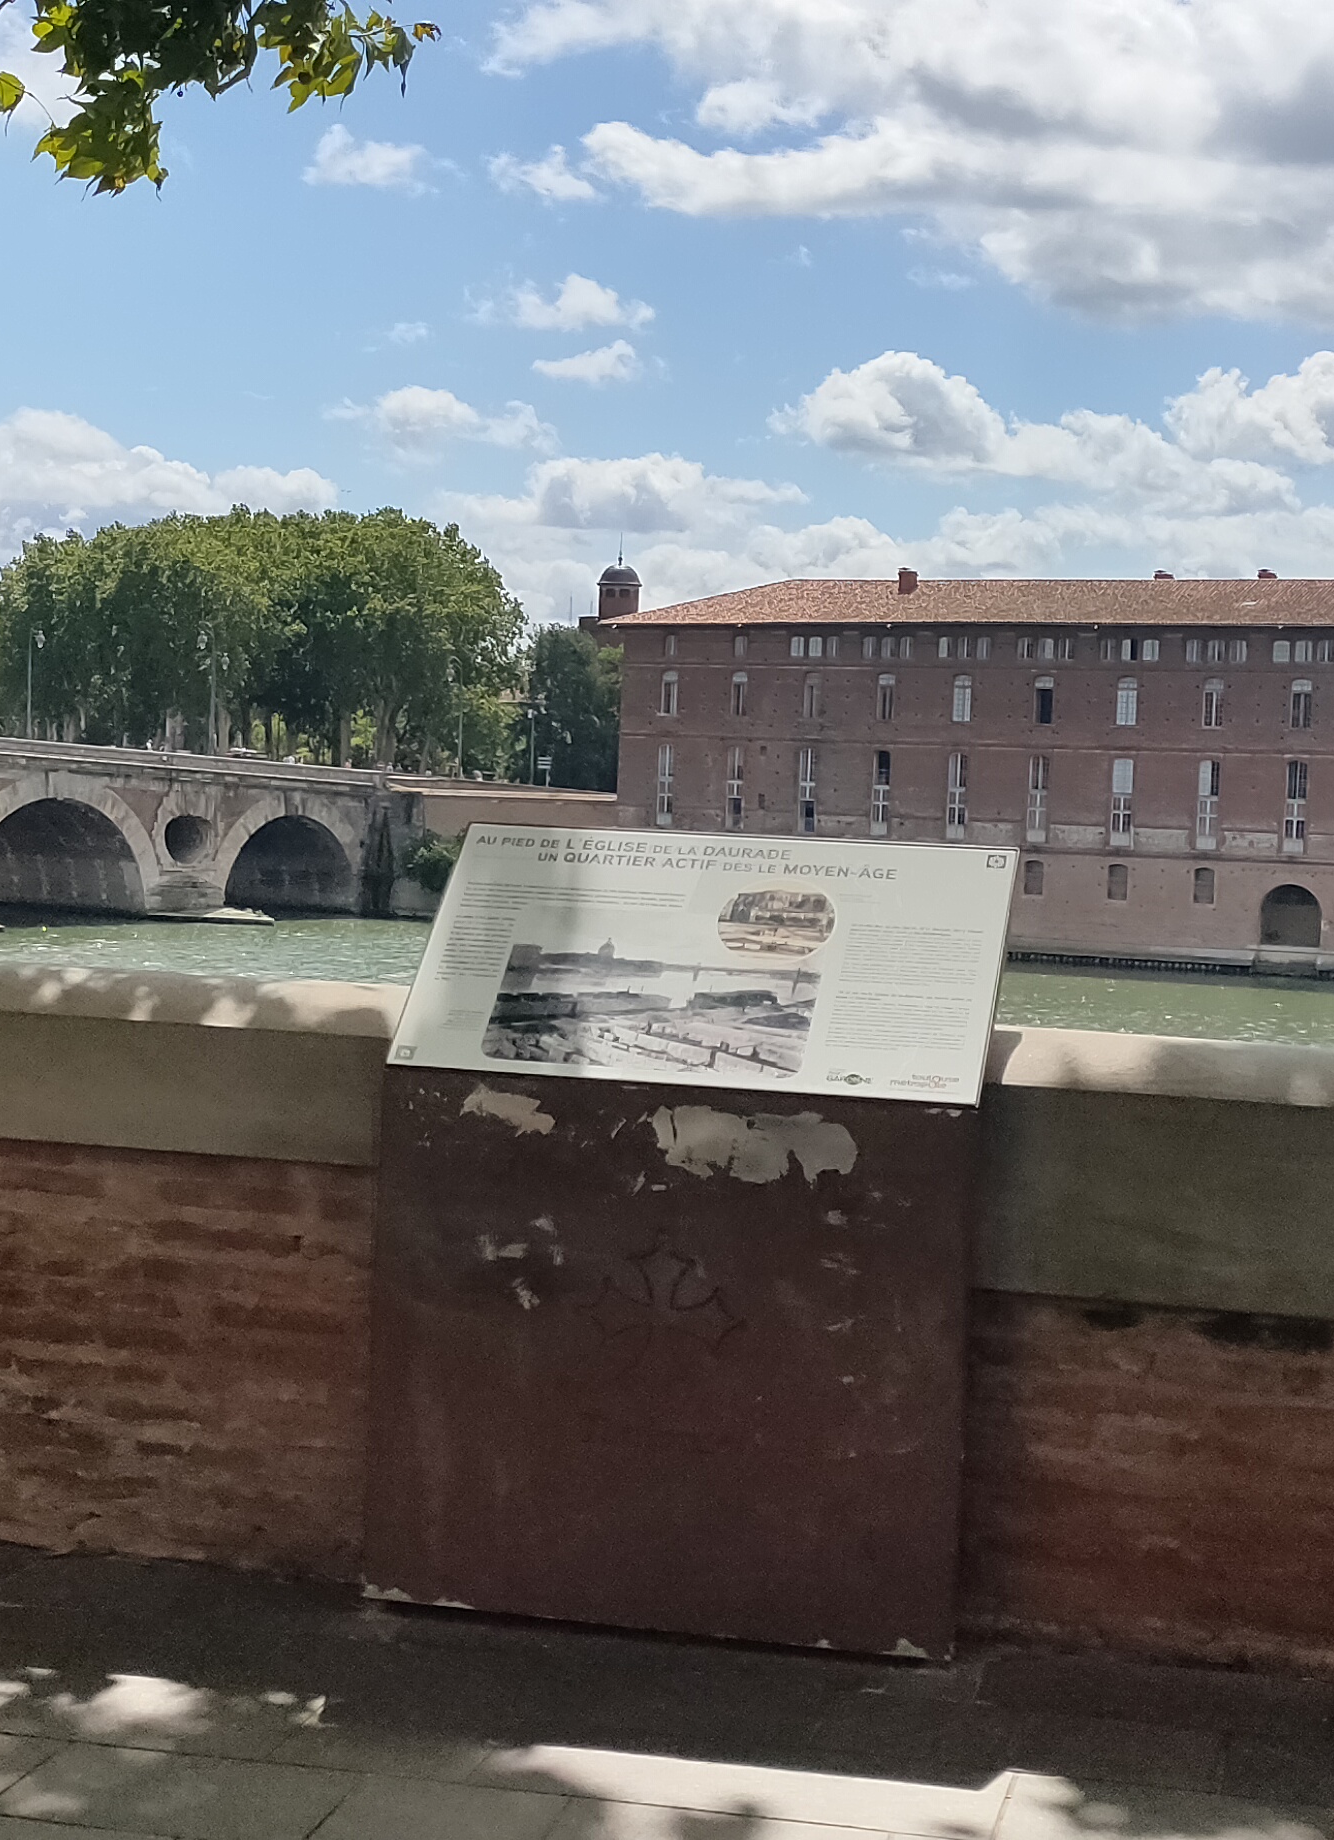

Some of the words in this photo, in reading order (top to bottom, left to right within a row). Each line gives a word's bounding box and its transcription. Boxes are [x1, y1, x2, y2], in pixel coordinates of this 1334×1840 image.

[476, 835, 497, 846] AU
[501, 837, 535, 848] PIED
[540, 838, 560, 849] DE
[653, 845, 674, 855] DE
[677, 846, 698, 856] LA
[703, 846, 792, 861] DAURADE
[537, 852, 558, 862] UN
[563, 852, 656, 868] QUARTIER
[662, 856, 717, 870] ACTIF
[758, 863, 776, 874] LE
